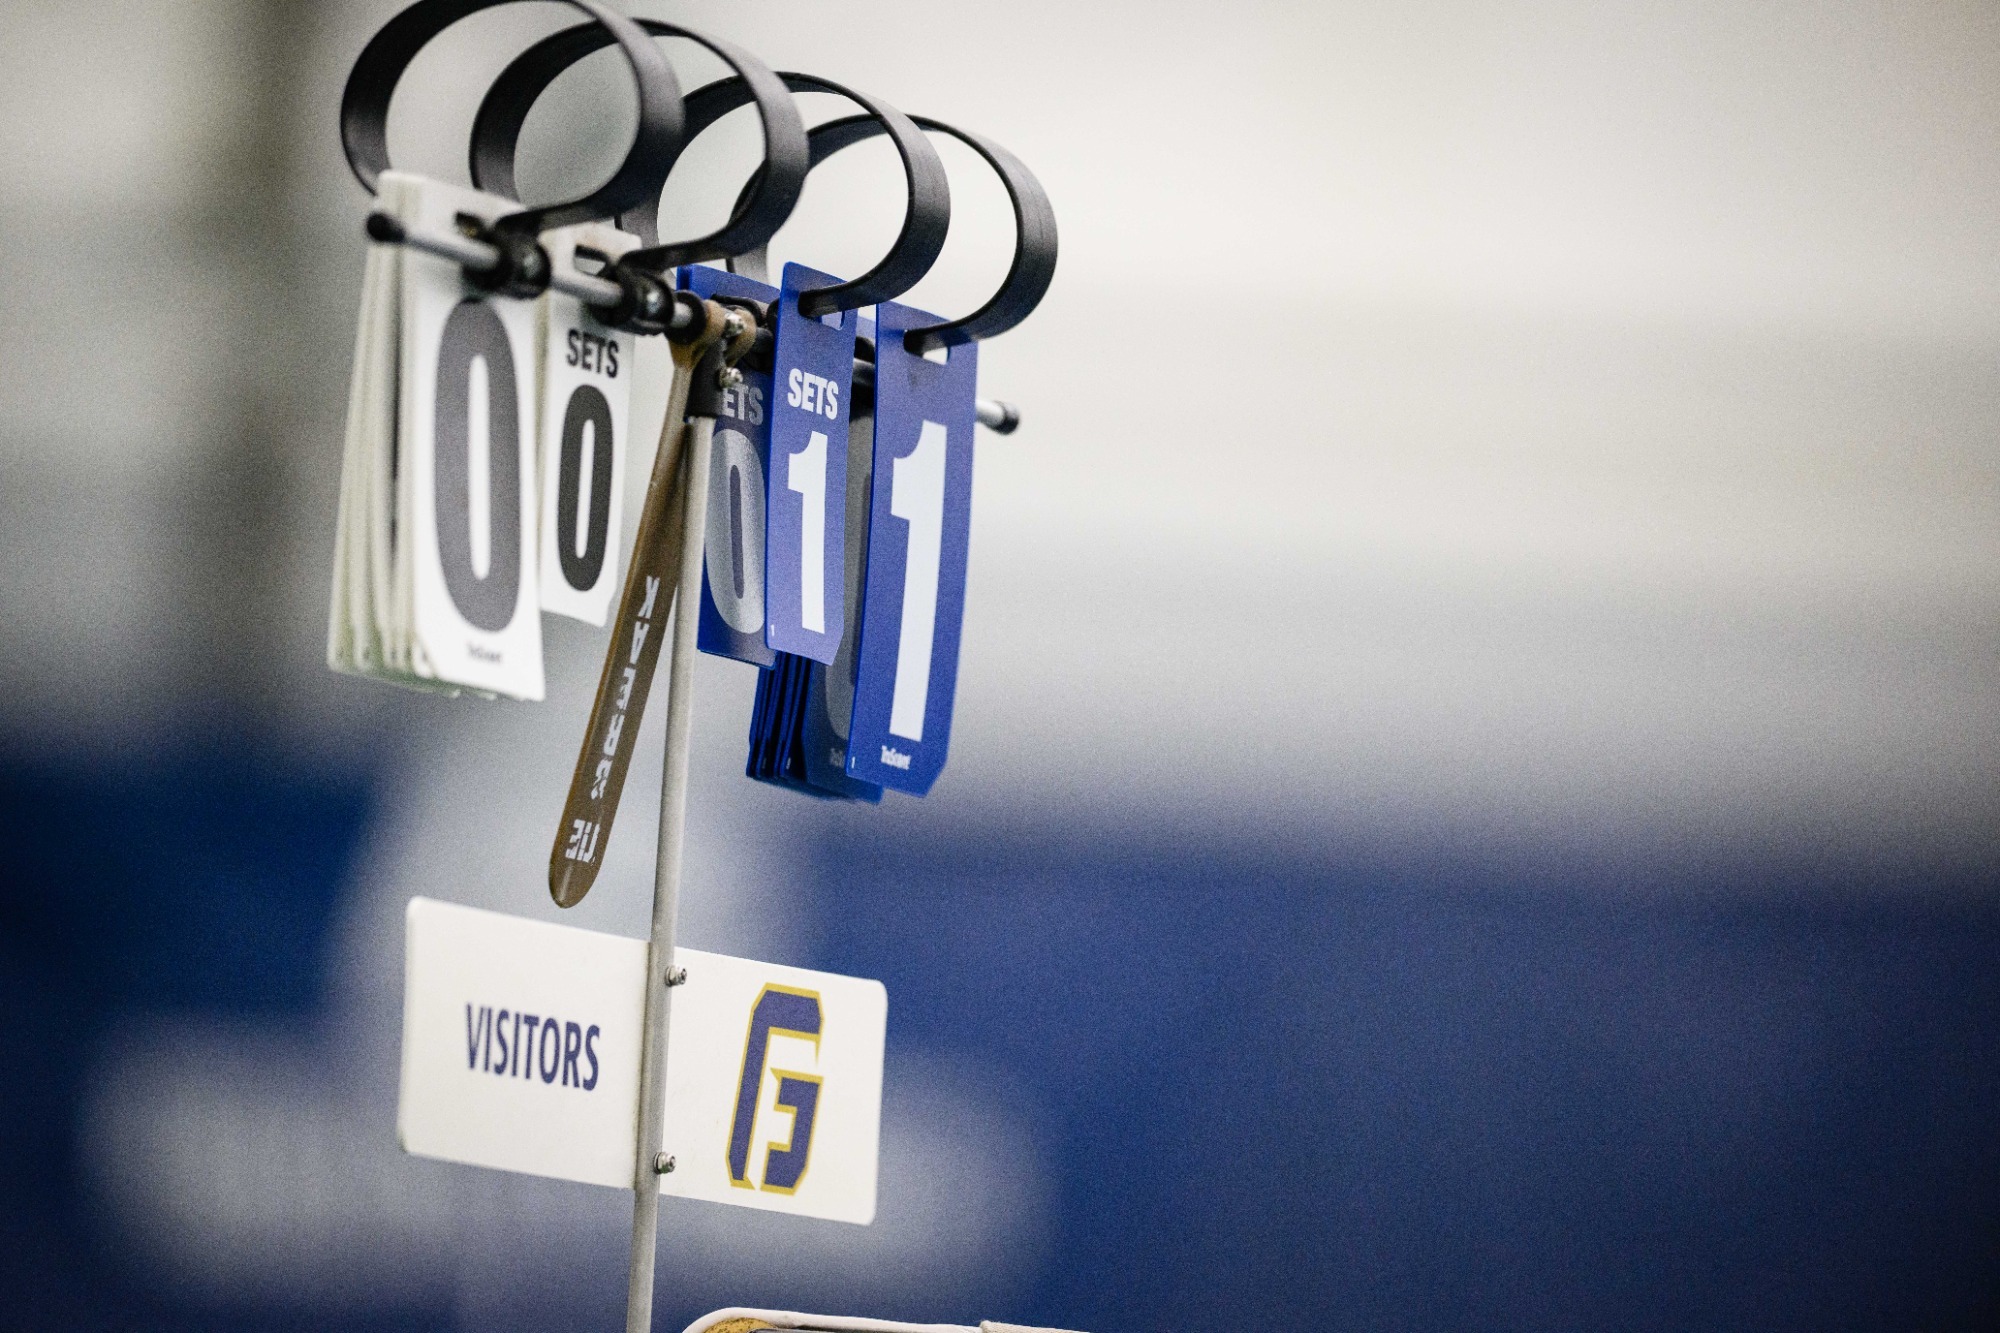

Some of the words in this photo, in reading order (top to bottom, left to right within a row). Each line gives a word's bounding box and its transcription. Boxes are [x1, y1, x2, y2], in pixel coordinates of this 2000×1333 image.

[566, 329, 619, 379] SETS
[721, 382, 764, 426] ETS
[787, 368, 839, 420] SETS
[433, 298, 522, 633] 0
[557, 384, 614, 593] 0
[704, 429, 766, 635] 0
[787, 430, 828, 635] 1
[890, 418, 948, 743] 1
[465, 1002, 601, 1092] VISITORS
